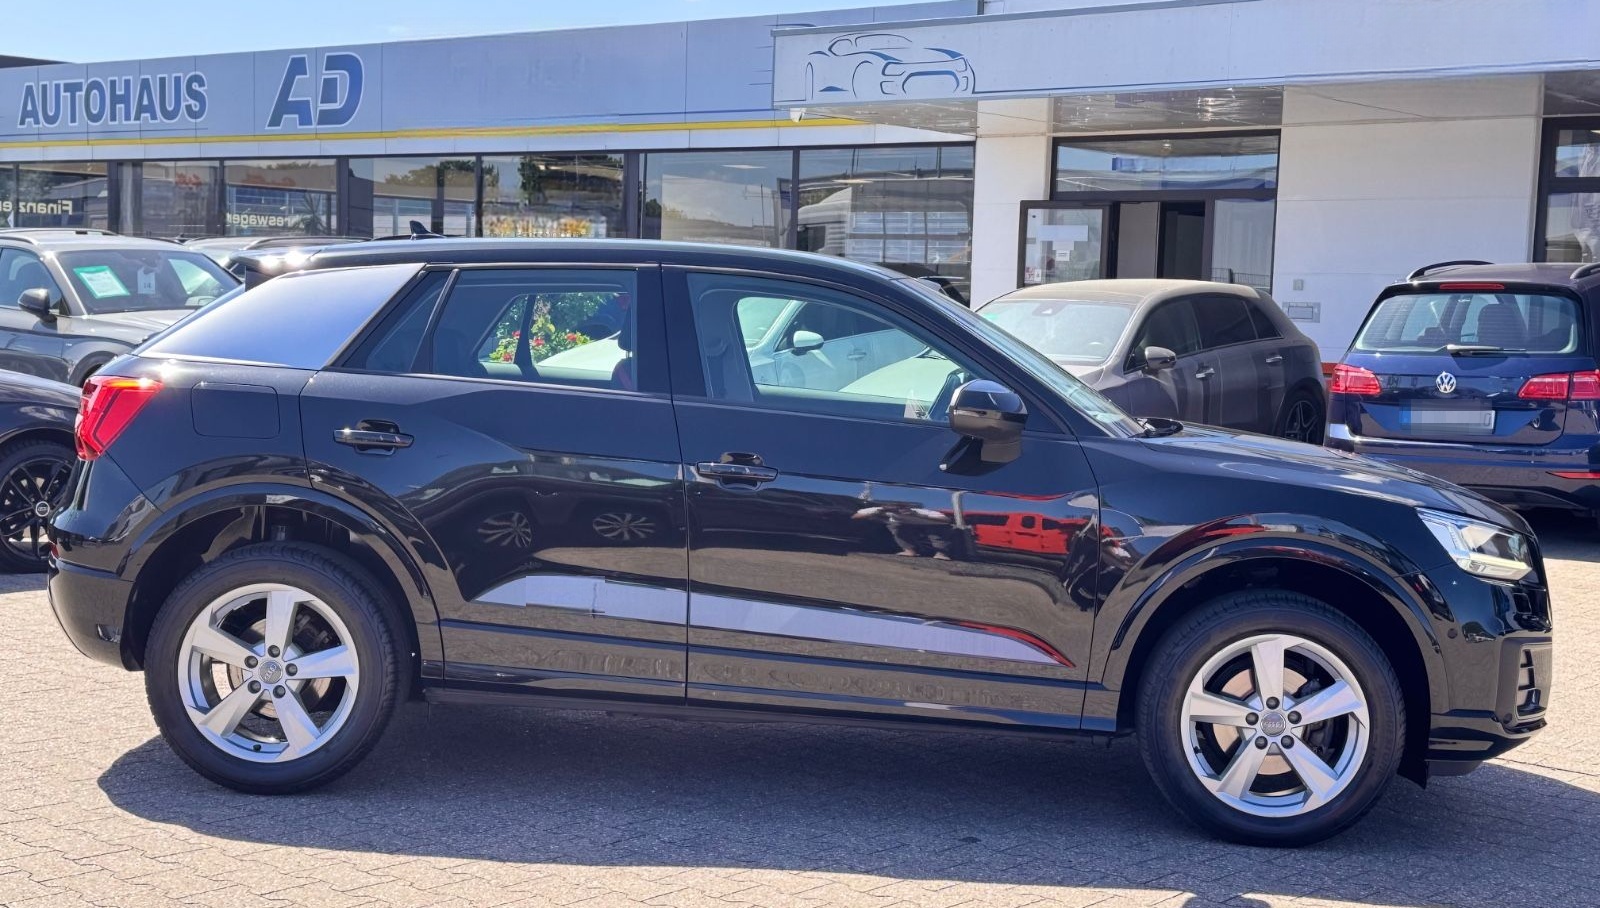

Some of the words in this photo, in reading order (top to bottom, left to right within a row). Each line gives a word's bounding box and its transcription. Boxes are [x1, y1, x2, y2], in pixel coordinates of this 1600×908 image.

[17, 71, 208, 128] AUTOHAUS
[265, 51, 365, 129] AD
[1435, 371, 1457, 393] VW
